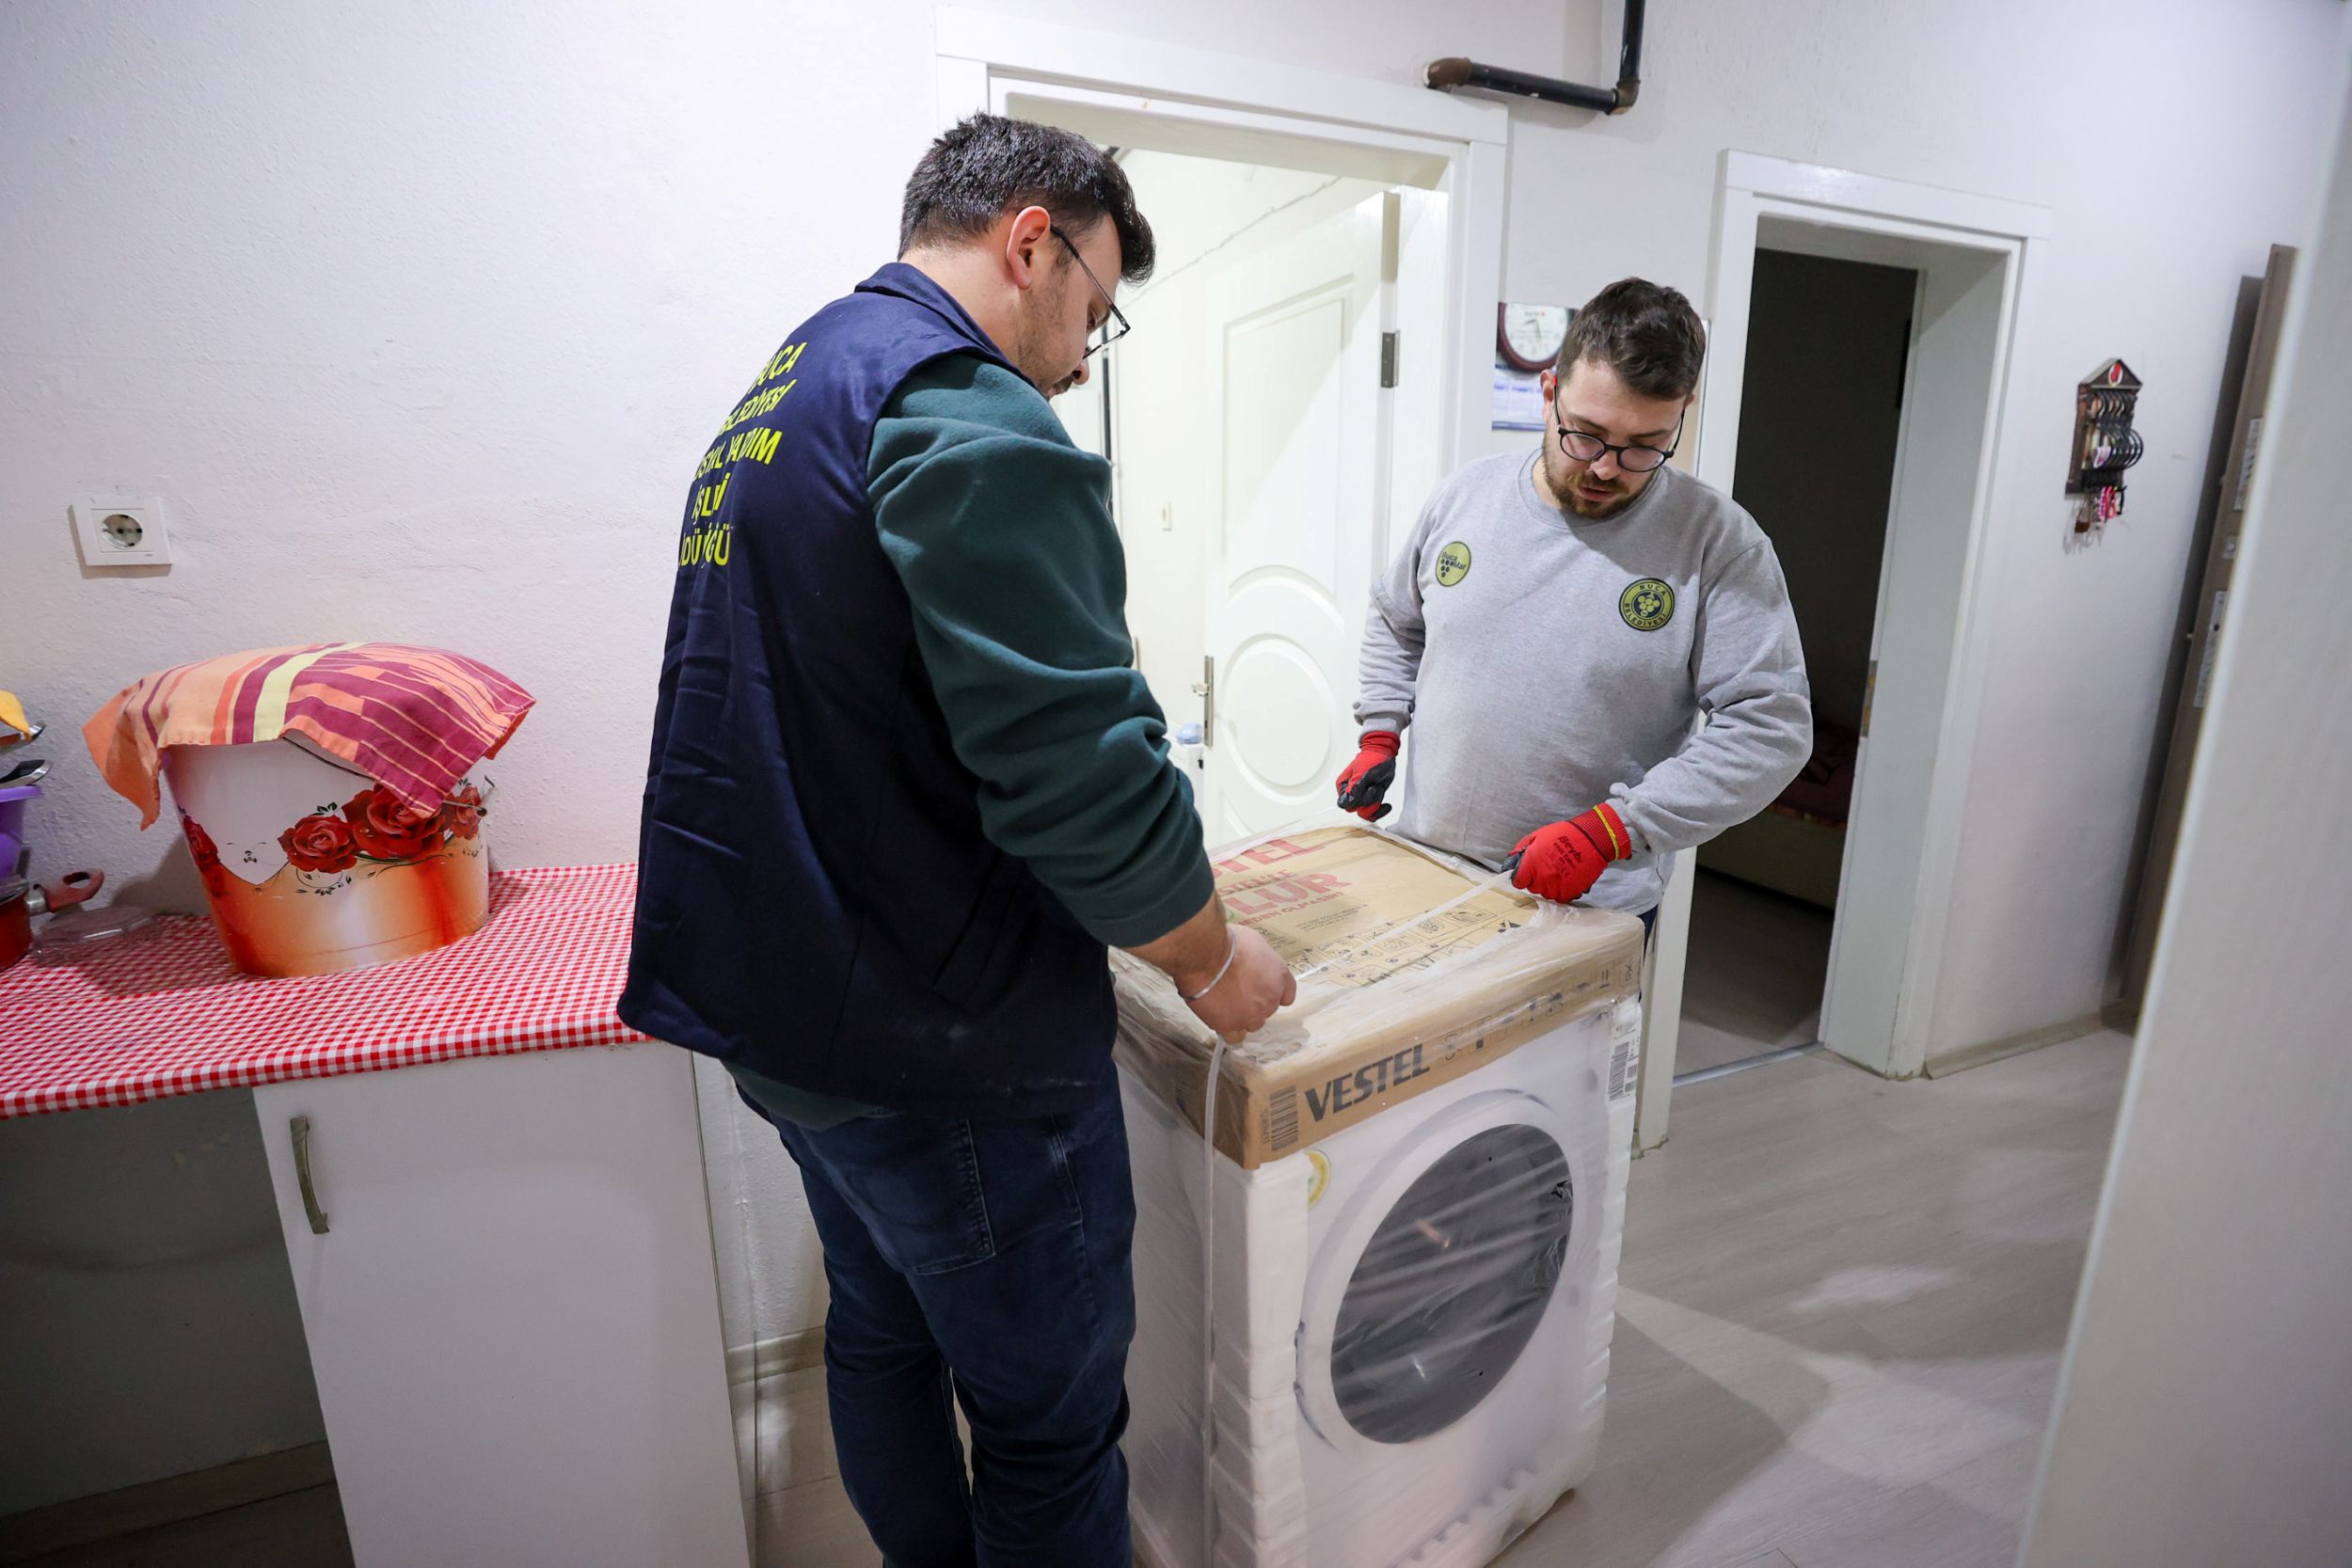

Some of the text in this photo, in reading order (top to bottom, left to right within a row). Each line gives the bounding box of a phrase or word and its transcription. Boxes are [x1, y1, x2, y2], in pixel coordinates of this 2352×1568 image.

[747, 341, 807, 393] UCA
[1639, 583, 1667, 595] BUCA
[1624, 602, 1667, 626] BELEDİYESİ
[1304, 1044, 1430, 1122] VESTEL
